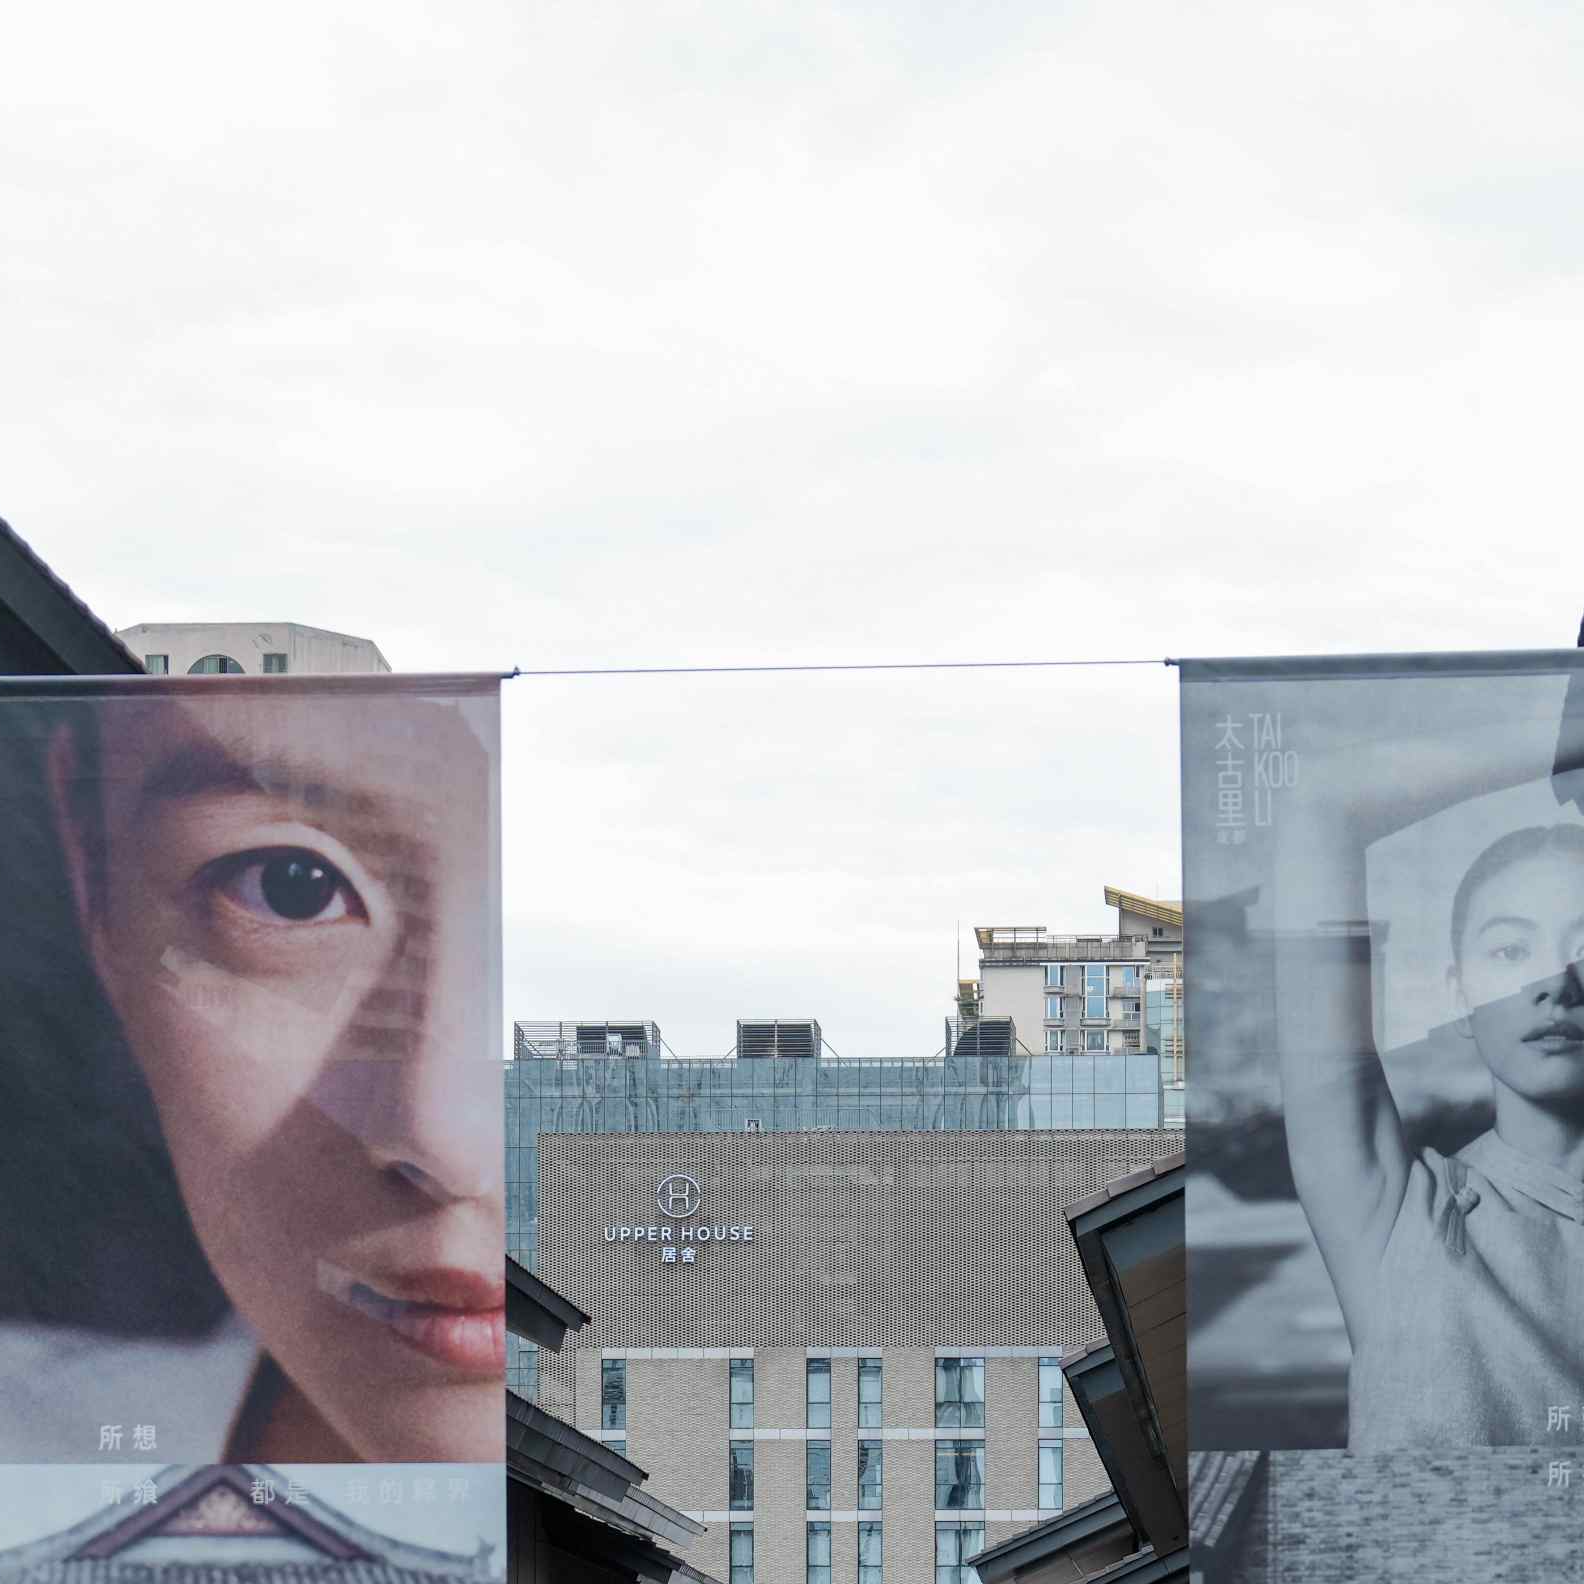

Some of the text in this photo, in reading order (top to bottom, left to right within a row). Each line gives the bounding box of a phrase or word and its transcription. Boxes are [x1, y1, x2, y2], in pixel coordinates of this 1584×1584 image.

[1249, 712, 1281, 749] TAI
[1216, 714, 1246, 827] 太古里
[1254, 751, 1297, 788] KOO
[1255, 789, 1272, 826] LI
[605, 1226, 753, 1241] UPPER HOUSE
[662, 1247, 696, 1263] 居舍
[98, 1424, 157, 1451] 所想
[249, 1478, 308, 1505] 都是
